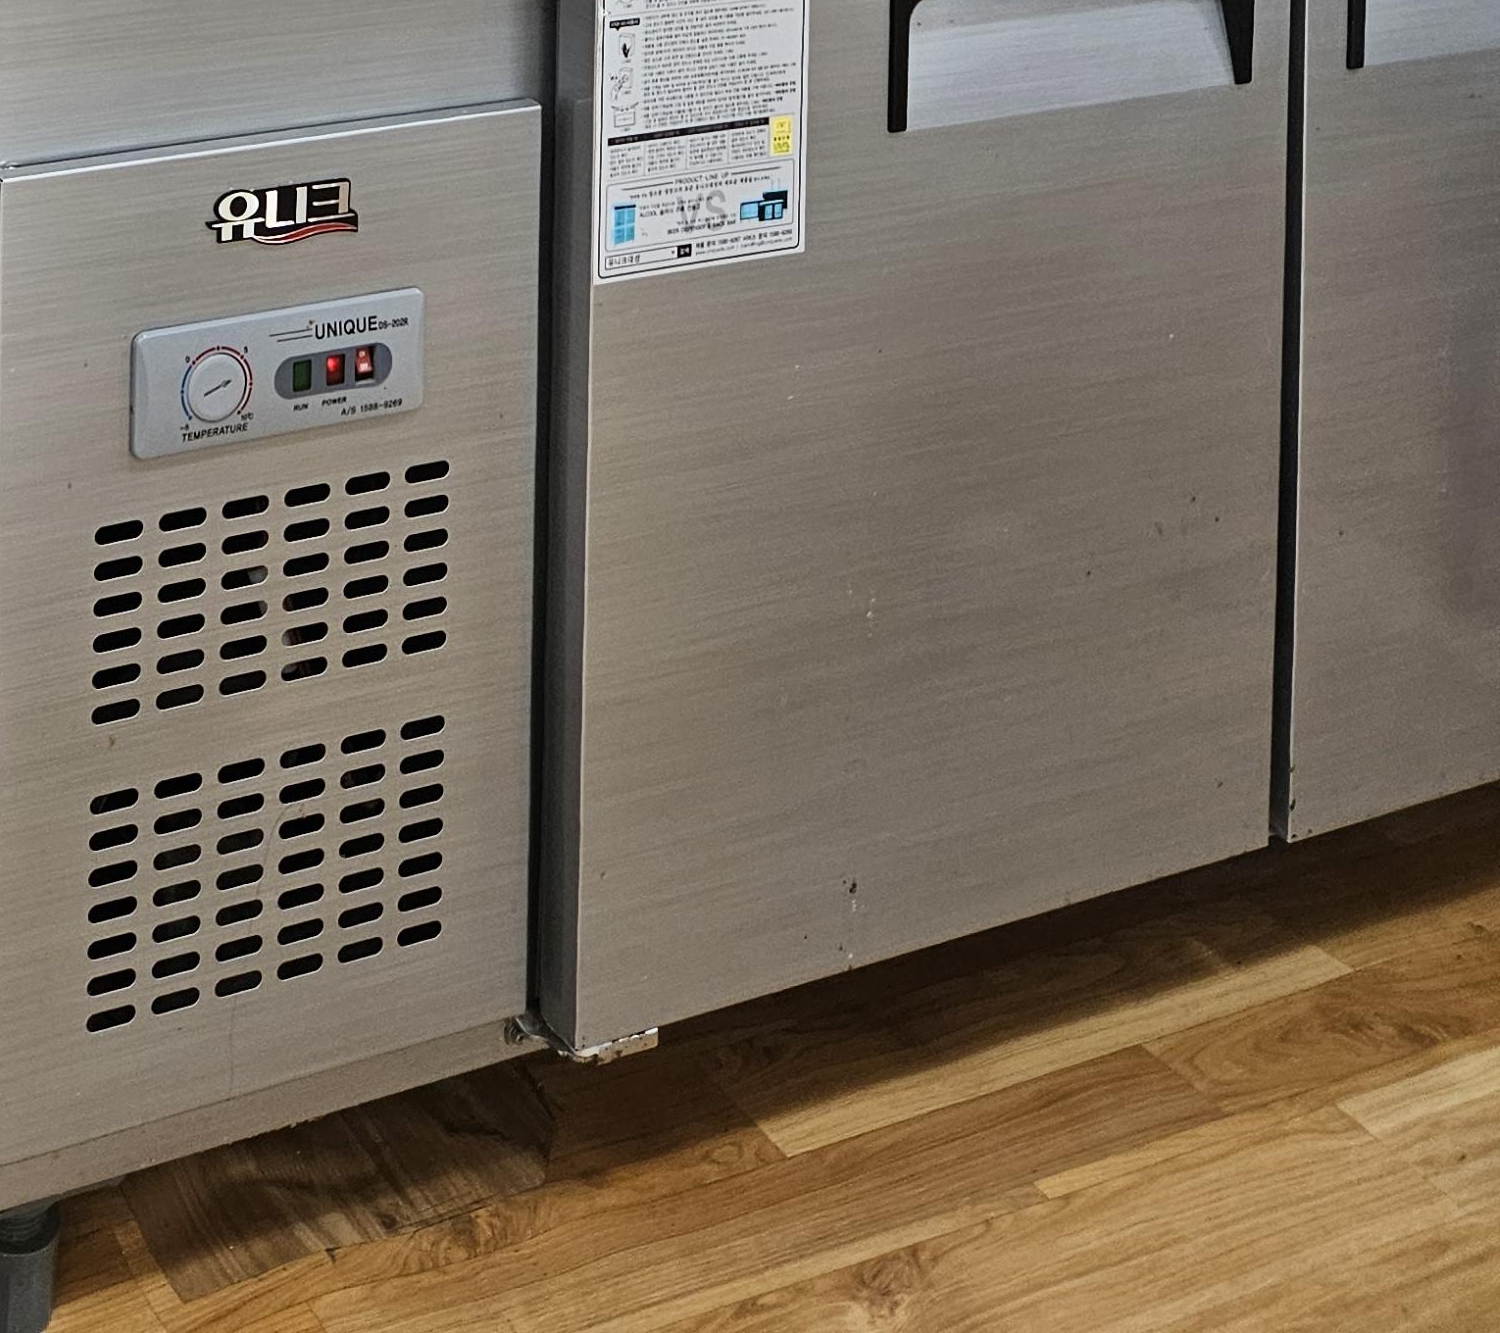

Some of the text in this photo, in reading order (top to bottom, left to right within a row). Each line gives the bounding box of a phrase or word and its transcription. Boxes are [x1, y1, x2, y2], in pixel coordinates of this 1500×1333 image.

[210, 179, 355, 242] 유니크
[315, 316, 378, 340] UNIQUE
[293, 403, 309, 412] RUN
[322, 396, 347, 407] POWER
[182, 422, 248, 442] TEMPERATURE
